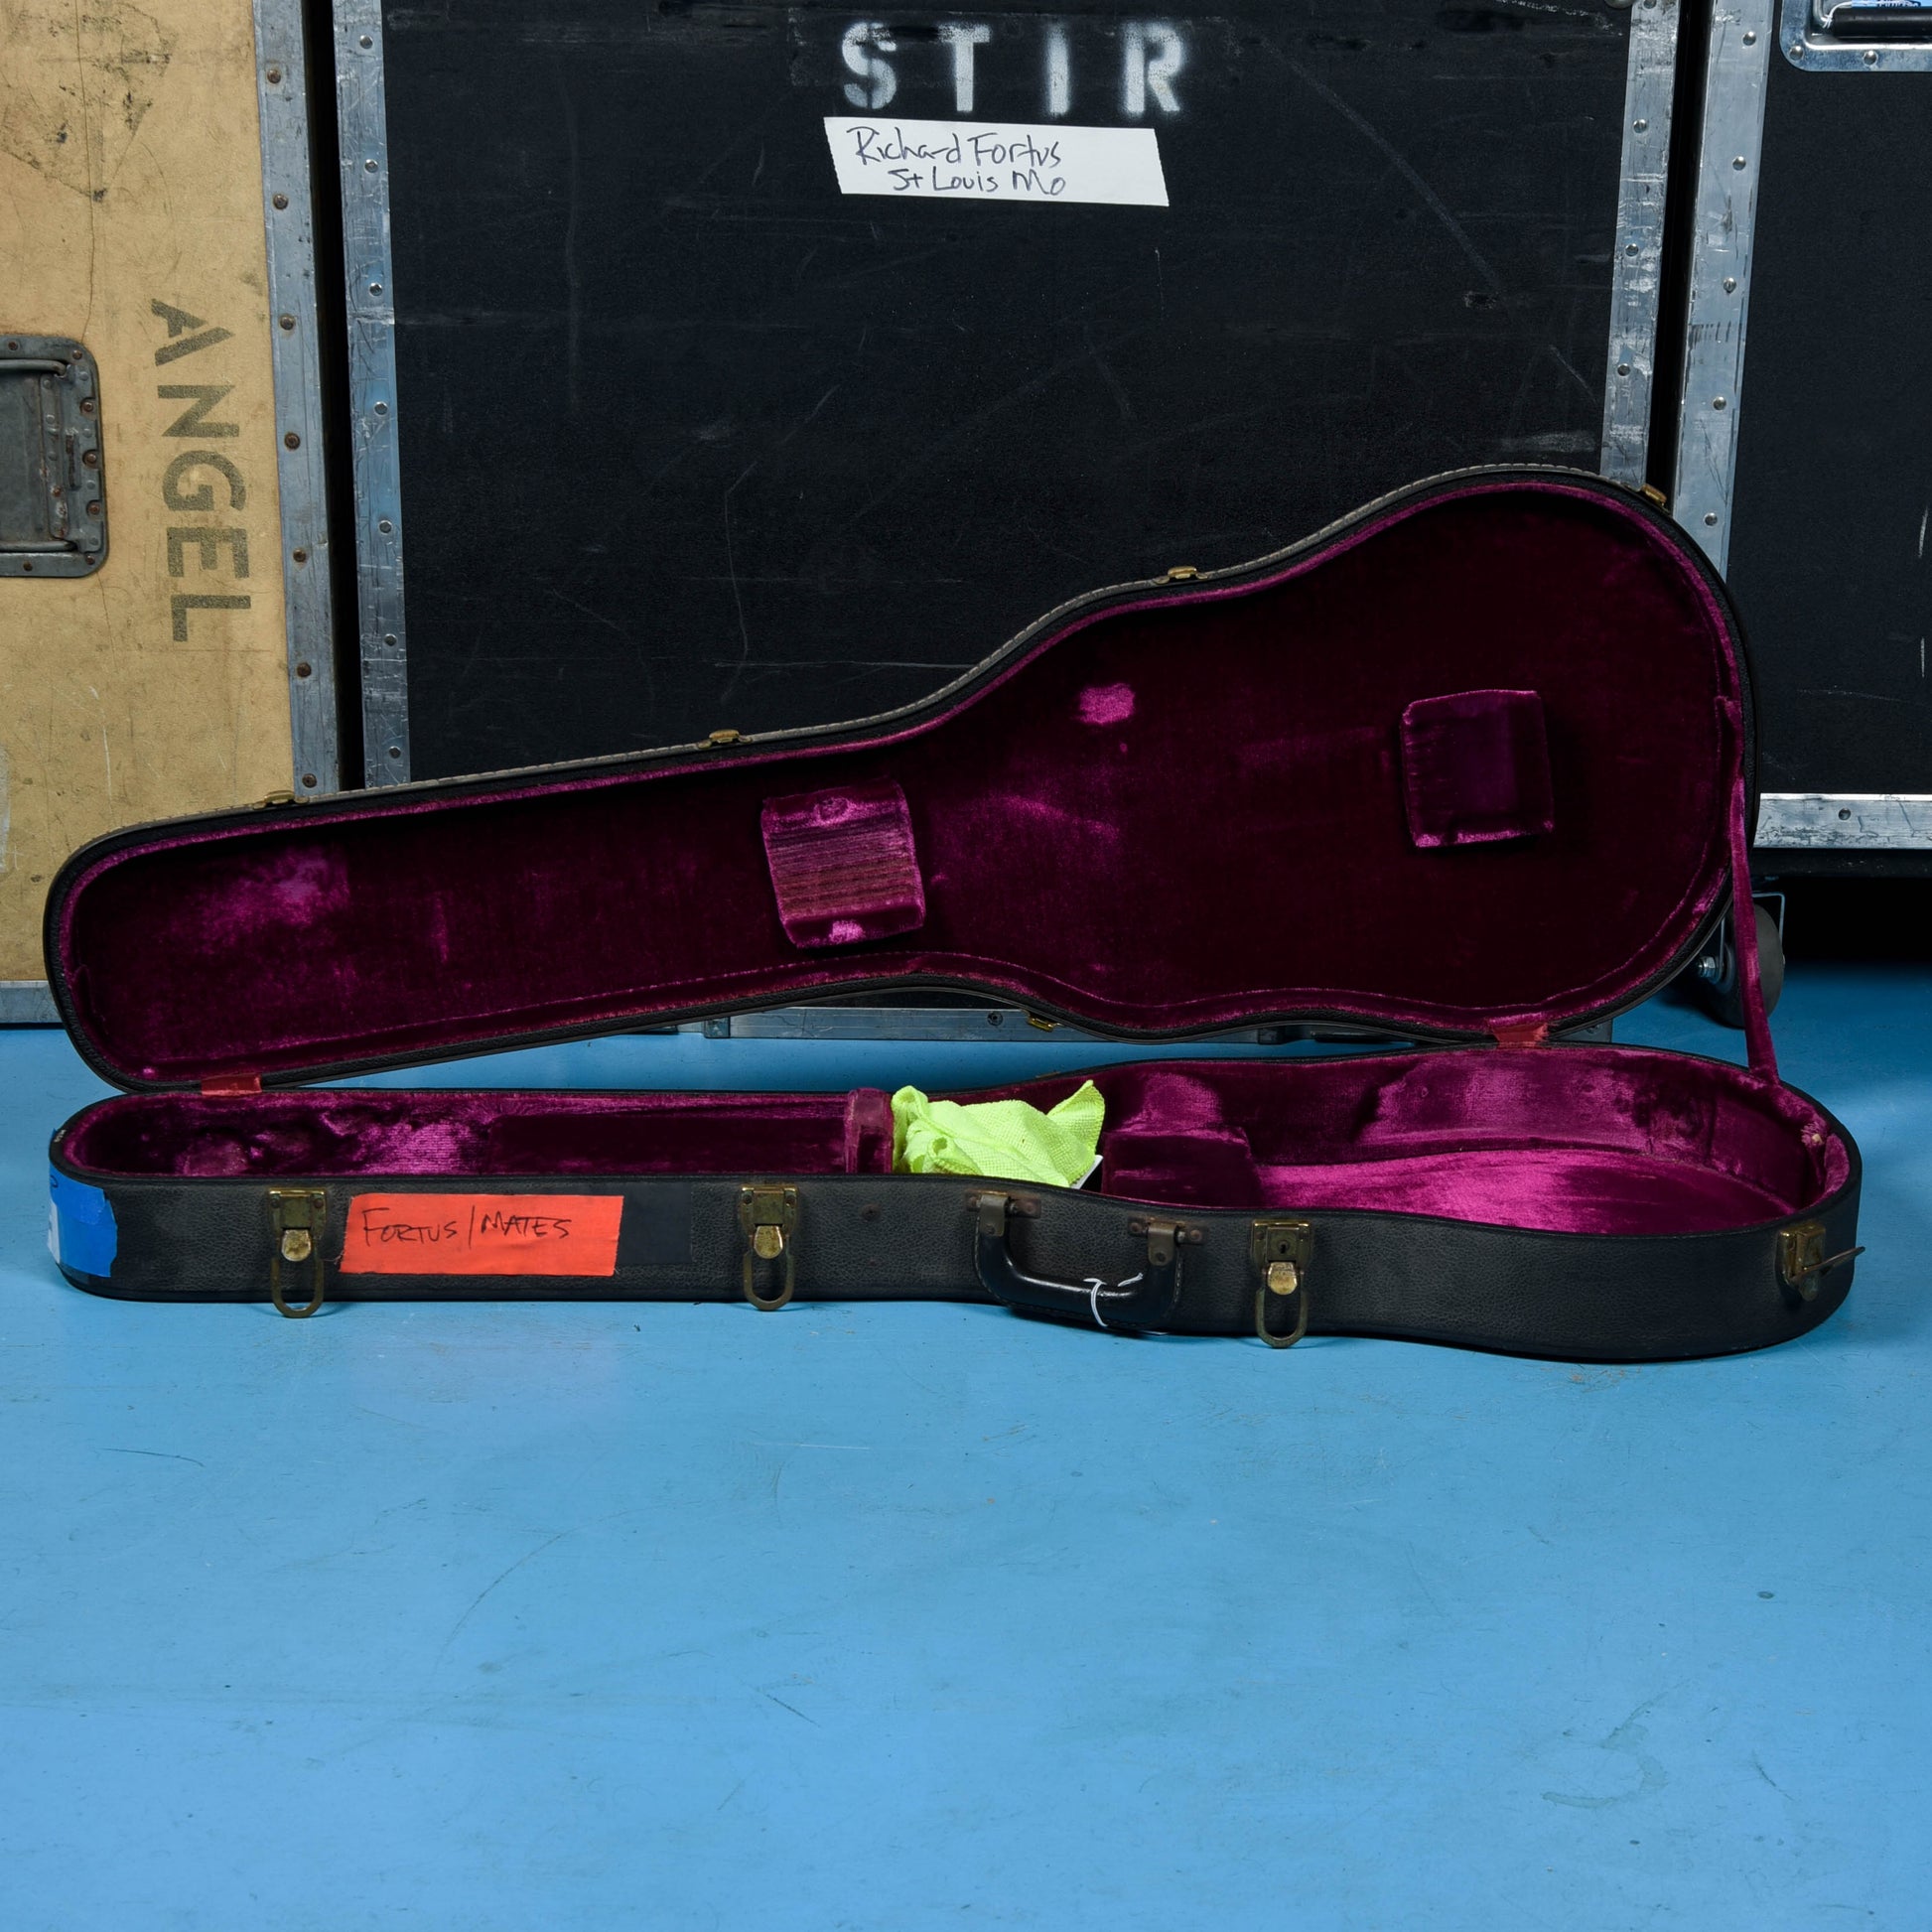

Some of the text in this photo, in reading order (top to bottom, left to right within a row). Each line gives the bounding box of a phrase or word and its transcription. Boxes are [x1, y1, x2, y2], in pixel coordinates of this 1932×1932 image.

[841, 21, 1185, 116] STIR
[846, 125, 1062, 169] Richard Fortus
[888, 168, 923, 192] St
[931, 166, 999, 193] Louis
[150, 298, 252, 642] ANGEL
